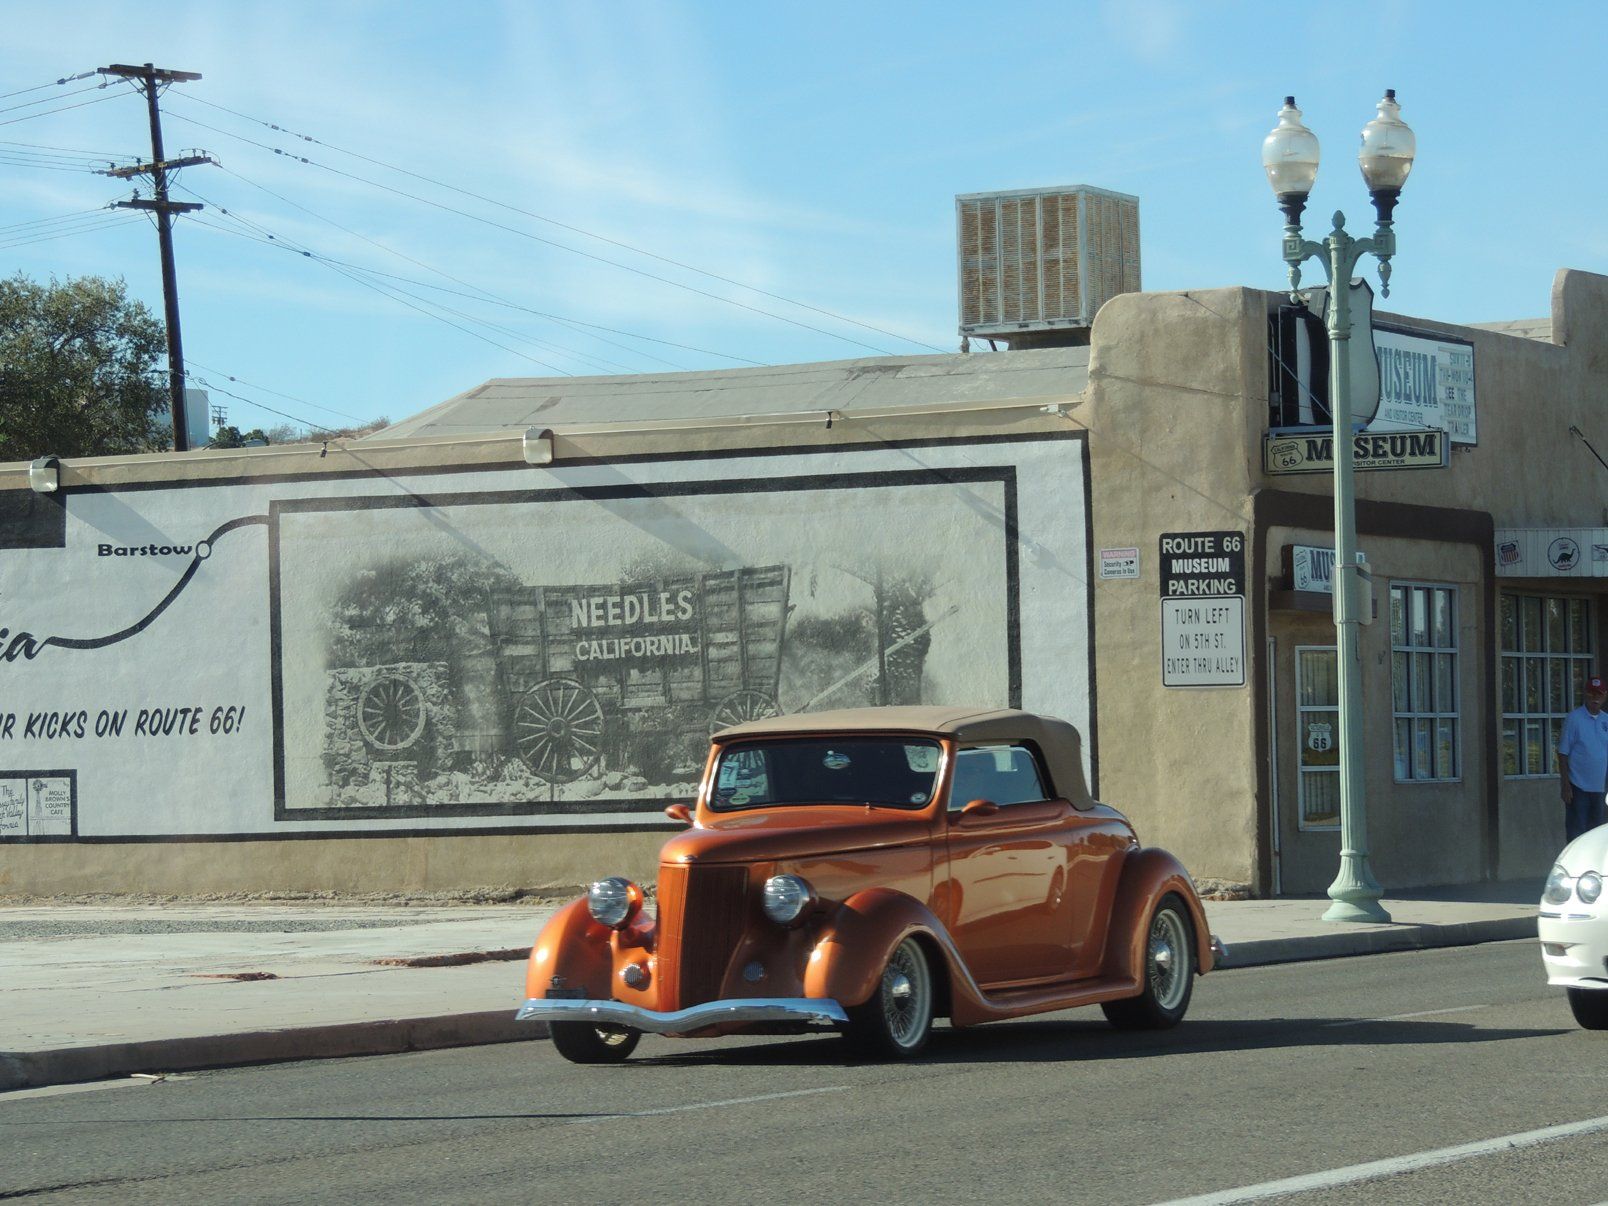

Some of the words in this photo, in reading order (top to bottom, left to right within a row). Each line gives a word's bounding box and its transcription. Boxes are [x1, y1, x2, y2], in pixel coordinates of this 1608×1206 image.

[1305, 434, 1437, 462] MSEUM
[1282, 456, 1297, 467] 66
[97, 543, 193, 557] Barstow
[1162, 537, 1215, 554] ROUTE
[1222, 536, 1241, 552] 66
[1103, 560, 1122, 568] Security
[1171, 557, 1230, 574] MUSEUM
[1168, 578, 1237, 595] PARKING
[571, 590, 693, 628] NEEDLES
[1175, 608, 1200, 624] TURN
[1205, 607, 1230, 624] LEFT
[0, 628, 46, 663] ia
[1179, 633, 1191, 649] ON
[1194, 633, 1210, 649] 5TH
[1214, 633, 1227, 649] ST.
[1167, 657, 1190, 674] ENTER
[1193, 657, 1212, 674] THRU
[1215, 657, 1239, 673] ALLEY
[24, 709, 88, 740] KICKS
[95, 708, 128, 738] ON
[135, 706, 203, 738] ROUTE
[210, 705, 246, 735] 66!
[1313, 737, 1327, 749] 66
